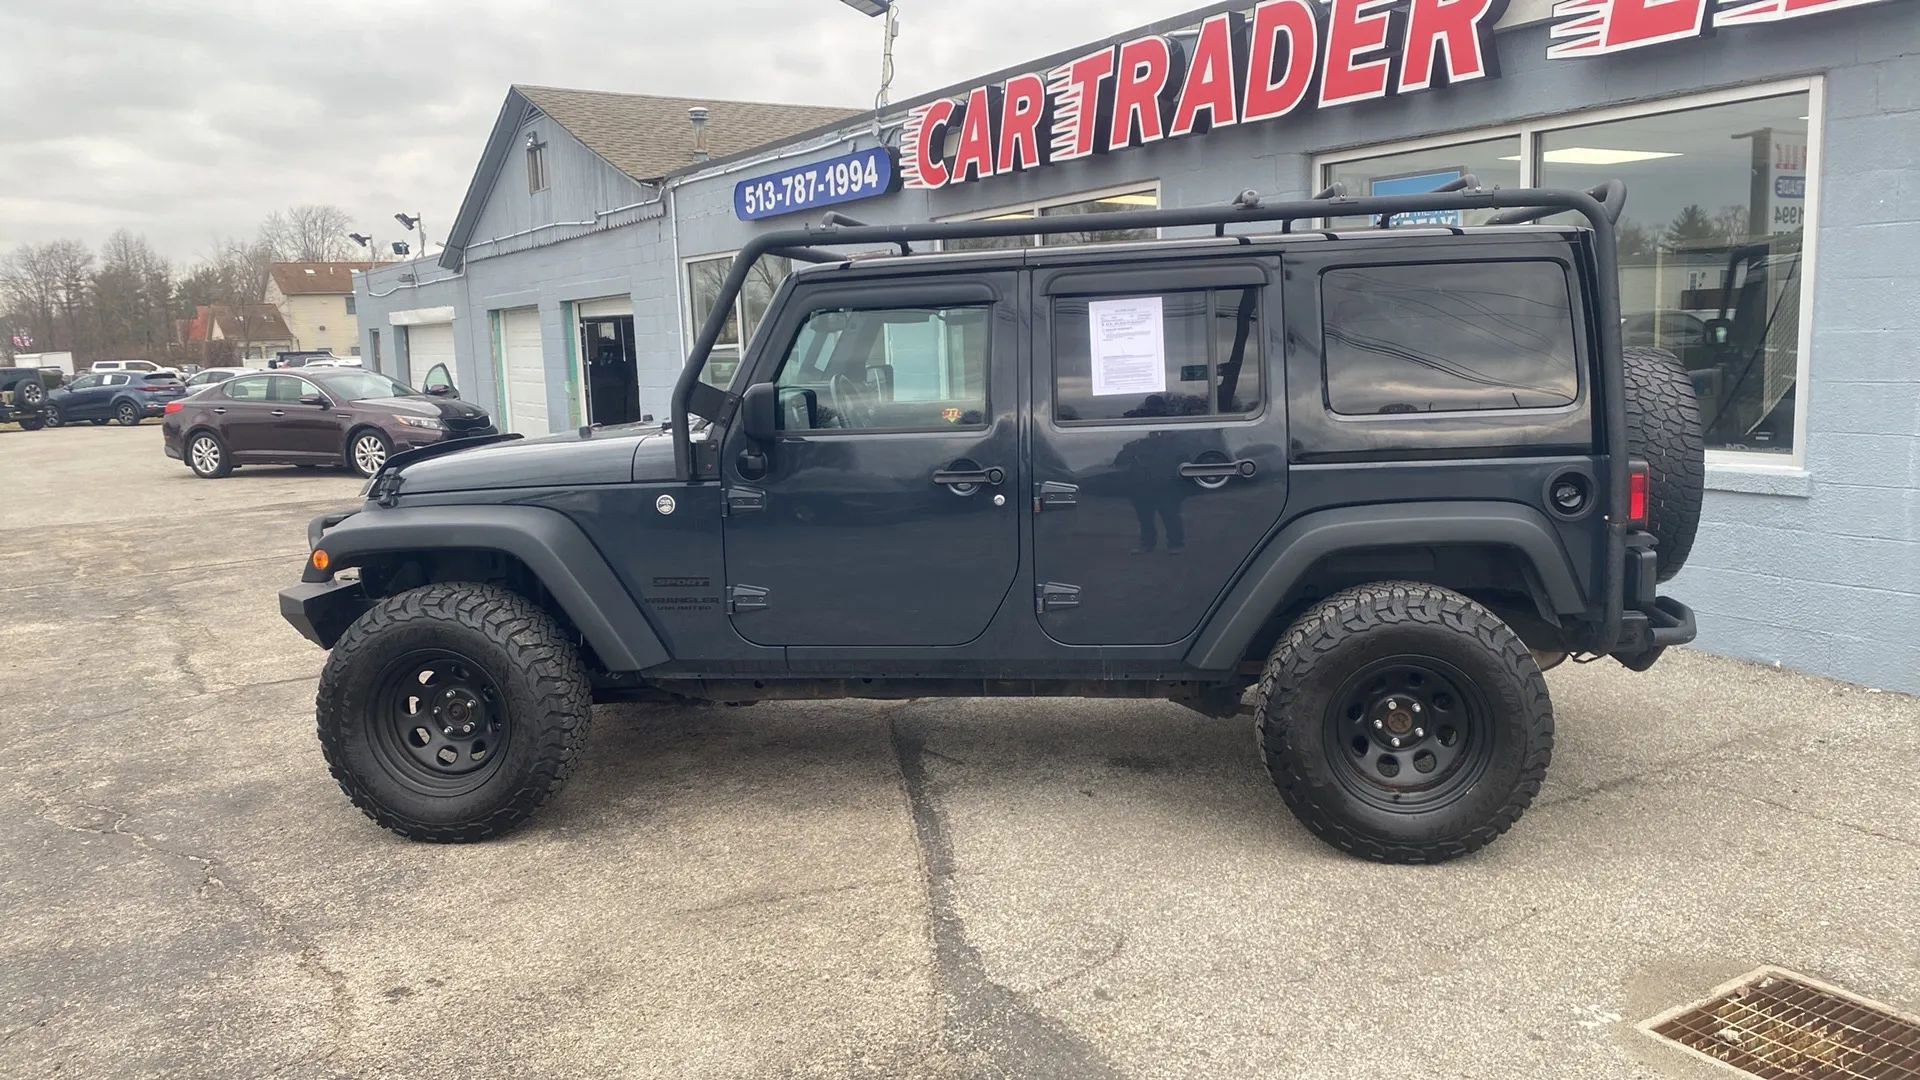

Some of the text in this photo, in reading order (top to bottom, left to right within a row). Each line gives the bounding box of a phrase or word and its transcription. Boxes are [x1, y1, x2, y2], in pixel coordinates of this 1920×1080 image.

[900, 73, 1046, 190] CAR
[1046, 0, 1495, 162] TRADER
[744, 155, 878, 215] 513-787-1994
